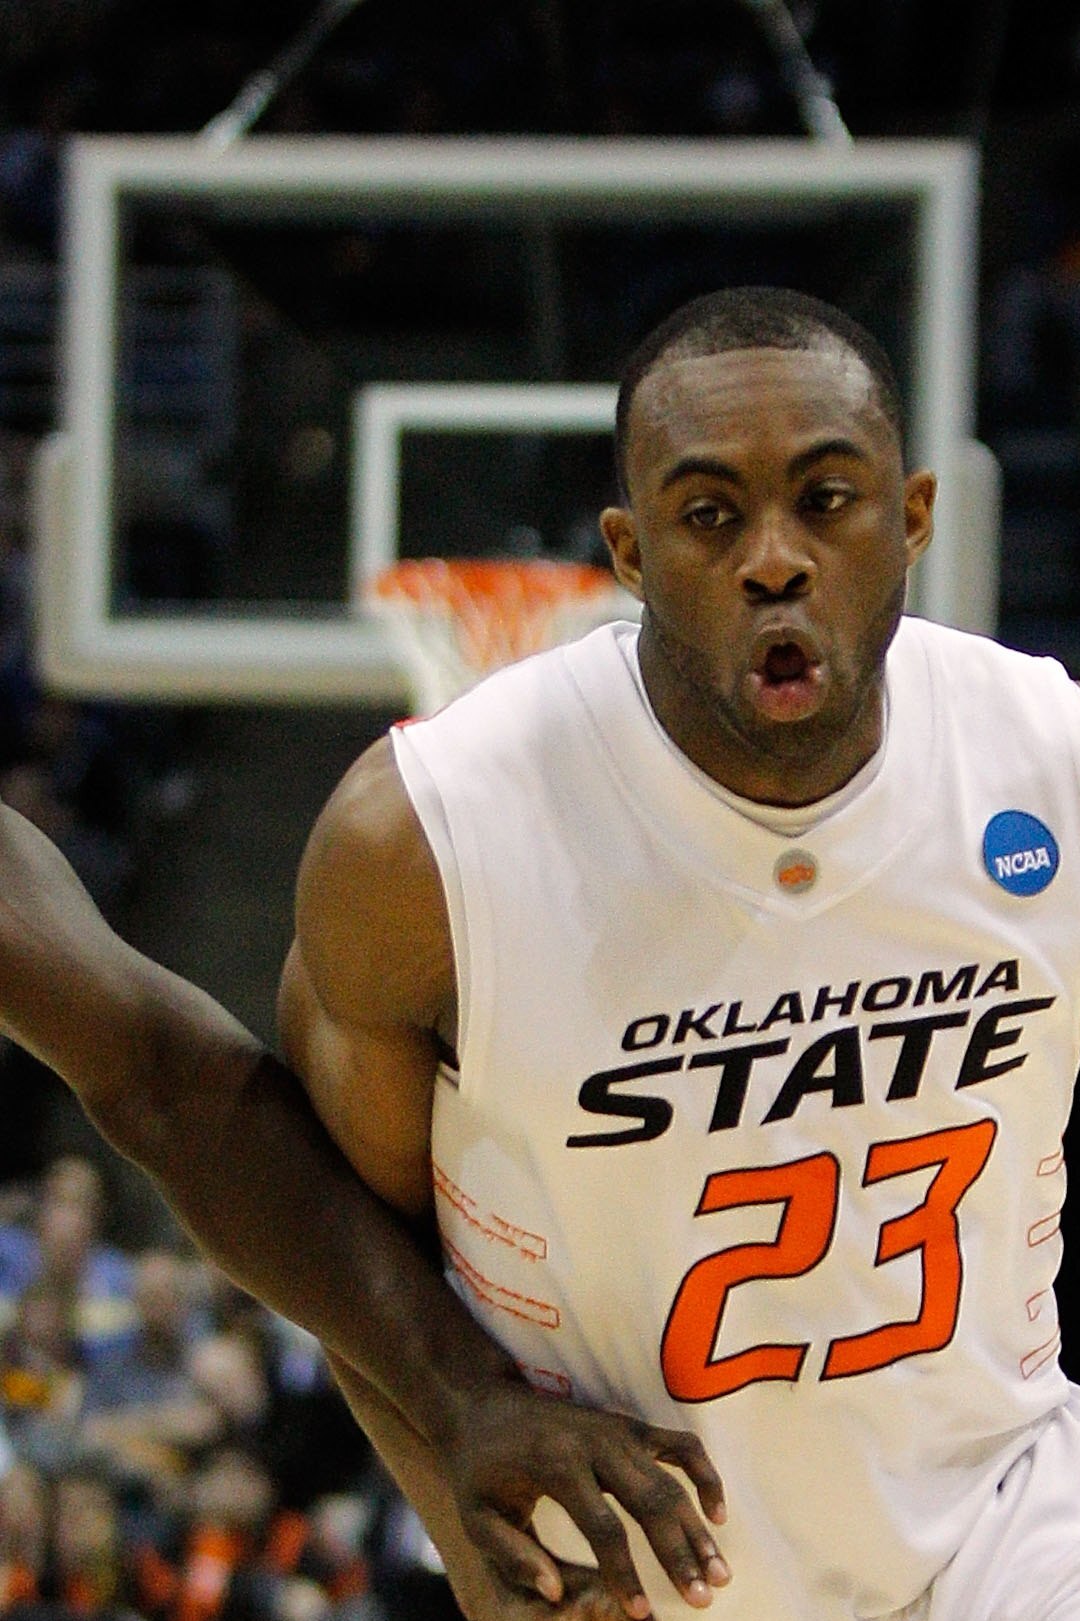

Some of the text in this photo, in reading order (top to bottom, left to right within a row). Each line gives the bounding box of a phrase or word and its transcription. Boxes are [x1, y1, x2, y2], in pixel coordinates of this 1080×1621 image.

[995, 847, 1051, 879] NCAA
[620, 958, 1021, 1052] OKLAHOMA
[566, 995, 1057, 1148] STATE
[660, 1117, 998, 1404] 23
